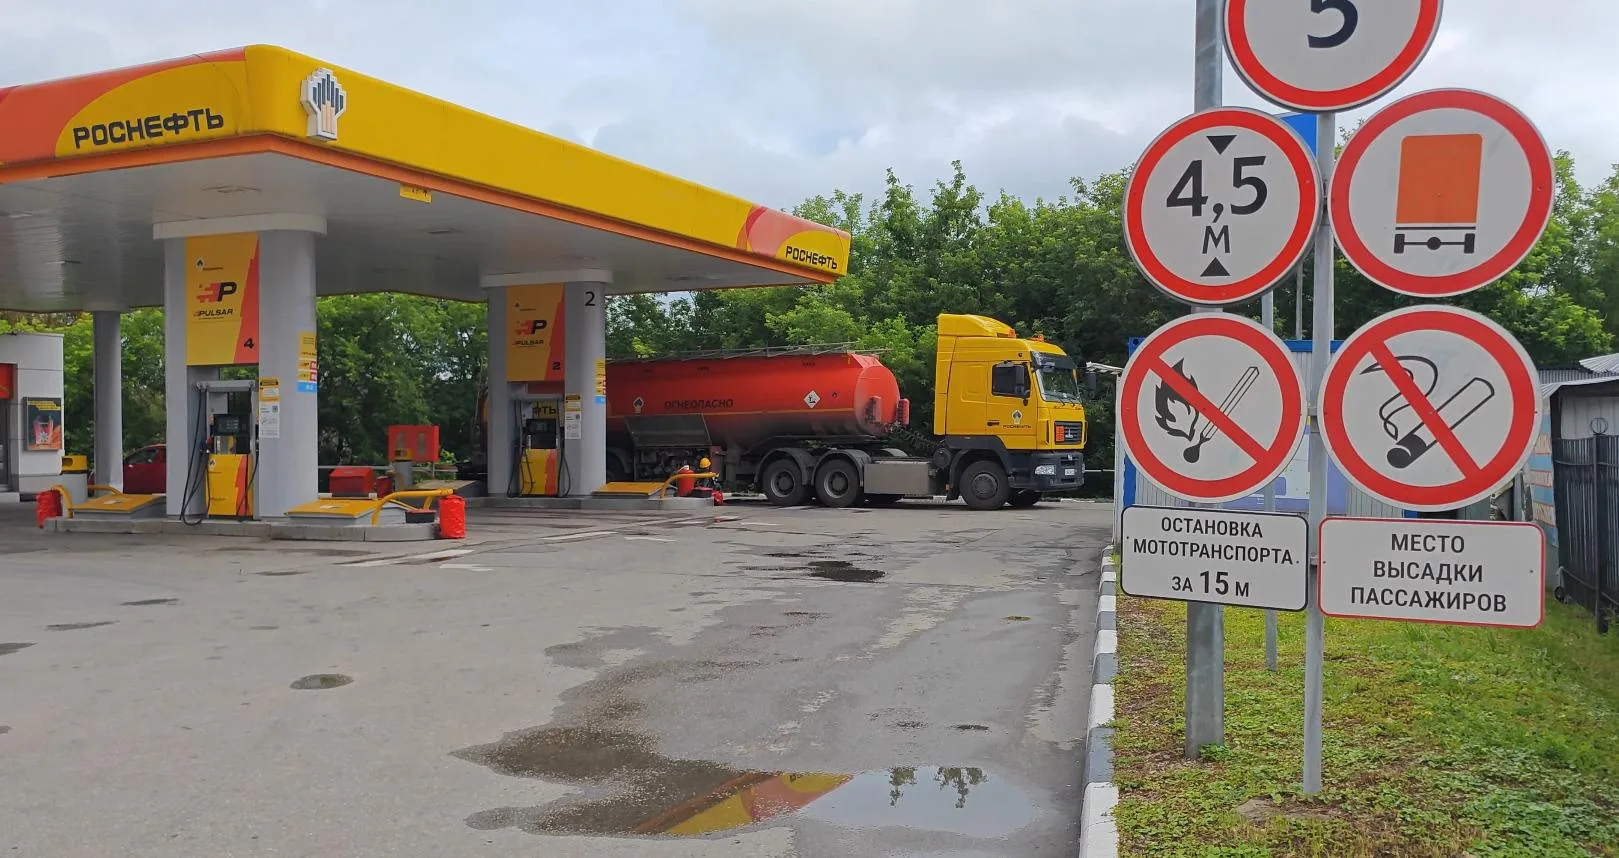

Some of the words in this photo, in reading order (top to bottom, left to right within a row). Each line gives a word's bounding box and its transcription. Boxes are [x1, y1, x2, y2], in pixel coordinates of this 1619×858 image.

[1307, 0, 1359, 49] 5
[73, 108, 225, 150] РОСНЕФТЬ
[1166, 155, 1268, 224] 4,5
[785, 245, 838, 270] РОСНЕФТЬ
[584, 291, 596, 307] 2
[198, 308, 233, 317] PULSAR
[243, 338, 254, 349] 4
[664, 398, 734, 409] ОГНЕОПАСНО
[1160, 516, 1264, 539] ОСТАНОВКА
[1132, 538, 1293, 565] МОТОТРАНСПОРТА
[1391, 533, 1465, 554] МЕСТО
[1171, 575, 1194, 593] ЗА
[1199, 571, 1230, 597] 15
[1373, 560, 1483, 584] ВЫСАДКИ
[1351, 586, 1507, 613] ПАССАЖИРОВ
